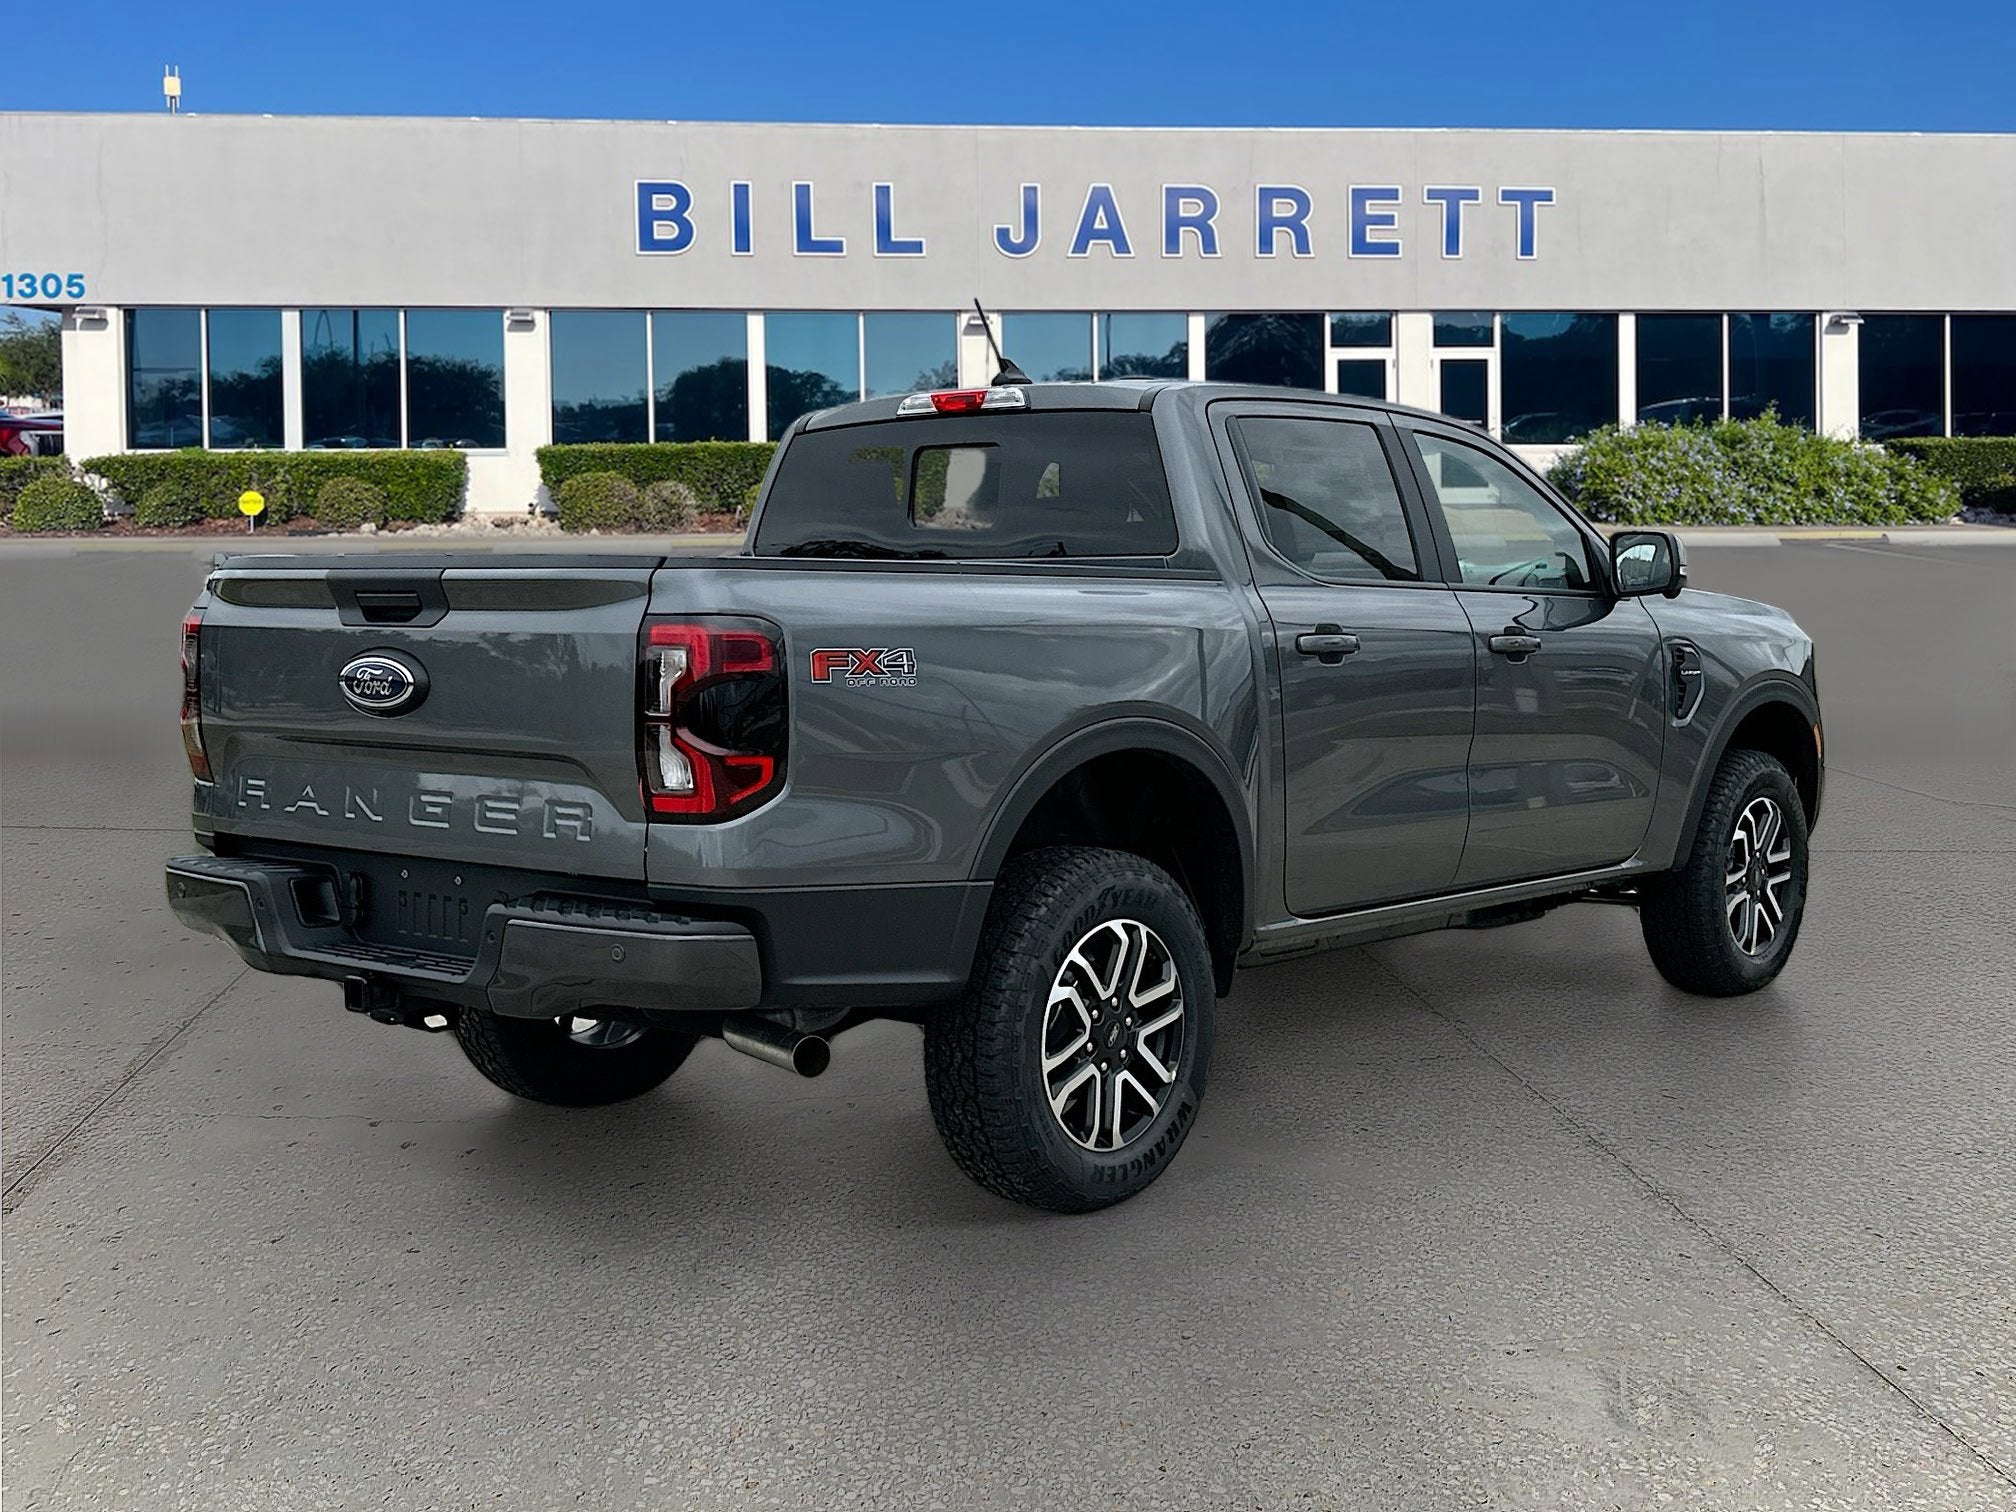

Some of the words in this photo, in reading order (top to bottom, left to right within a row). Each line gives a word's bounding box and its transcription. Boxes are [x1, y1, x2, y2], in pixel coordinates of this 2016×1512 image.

[635, 180, 926, 257] BILL
[994, 183, 1556, 259] JARRETT
[1, 273, 85, 299] 1305
[352, 667, 394, 695] Ford
[810, 648, 917, 683] FX4
[846, 677, 876, 687] OFF
[880, 677, 917, 687] ROAD
[237, 776, 594, 842] RANGER
[1090, 1101, 1193, 1185] WRANGLER
